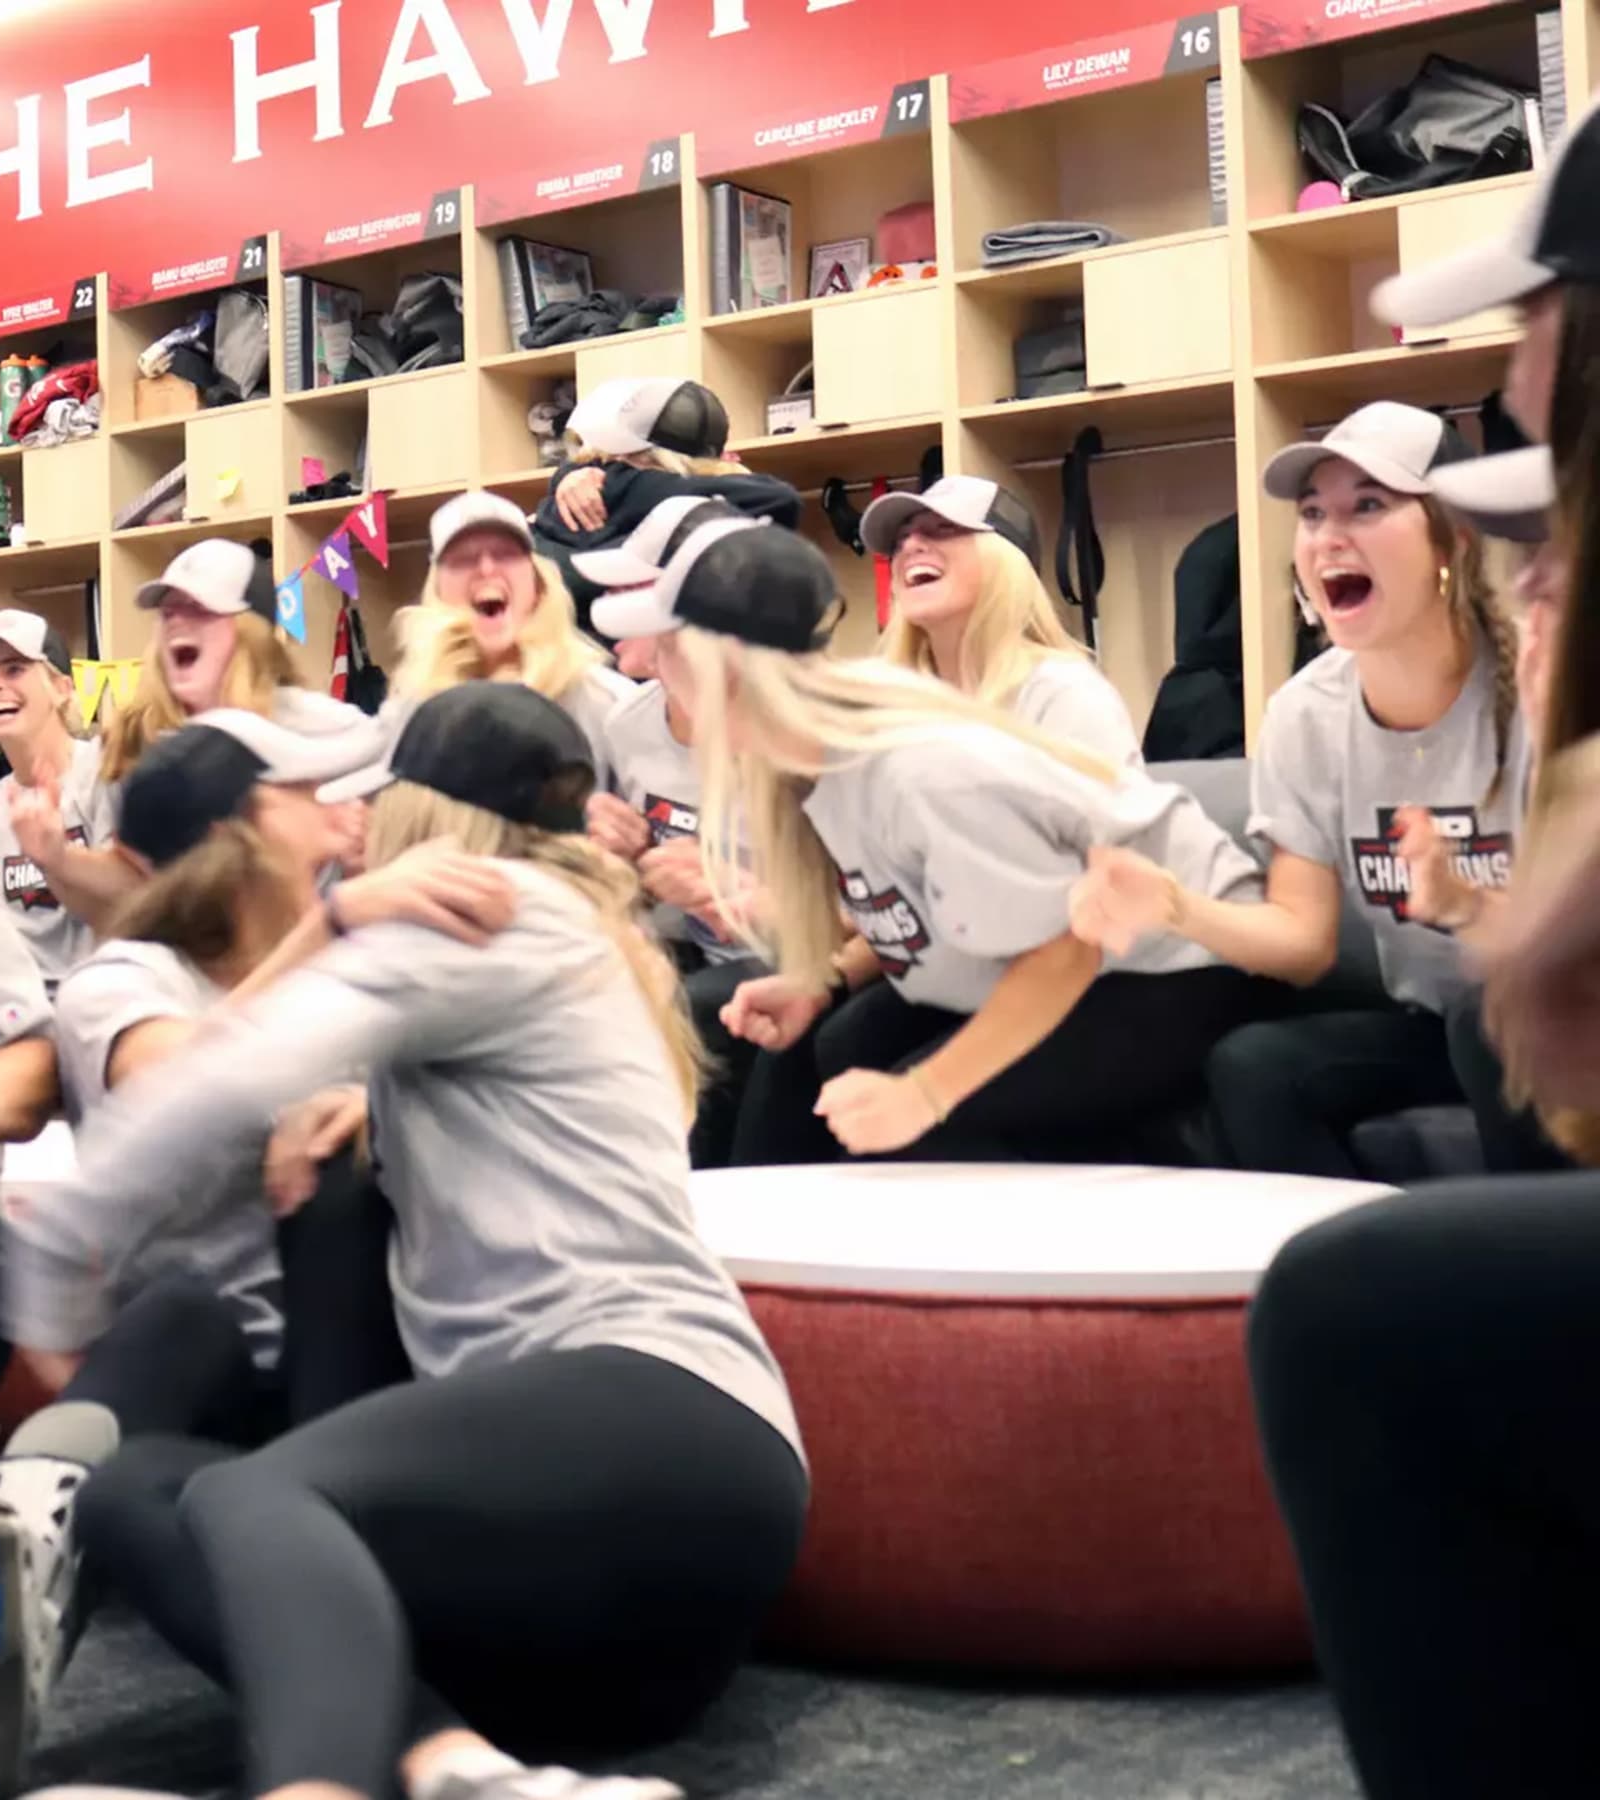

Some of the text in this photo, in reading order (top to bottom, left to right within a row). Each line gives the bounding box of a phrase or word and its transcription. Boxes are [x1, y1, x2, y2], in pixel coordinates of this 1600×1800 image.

[1180, 26, 1211, 57] 16
[1043, 48, 1131, 83] LILY DEWAN
[896, 93, 924, 121] 17
[754, 120, 816, 147] CAROLINE
[817, 105, 879, 134] BRICKLEY
[651, 150, 674, 177] 18
[434, 201, 456, 225] 19
[243, 246, 262, 269] 21
[75, 287, 93, 309] 22
[1358, 852, 1511, 894] CHAONS
